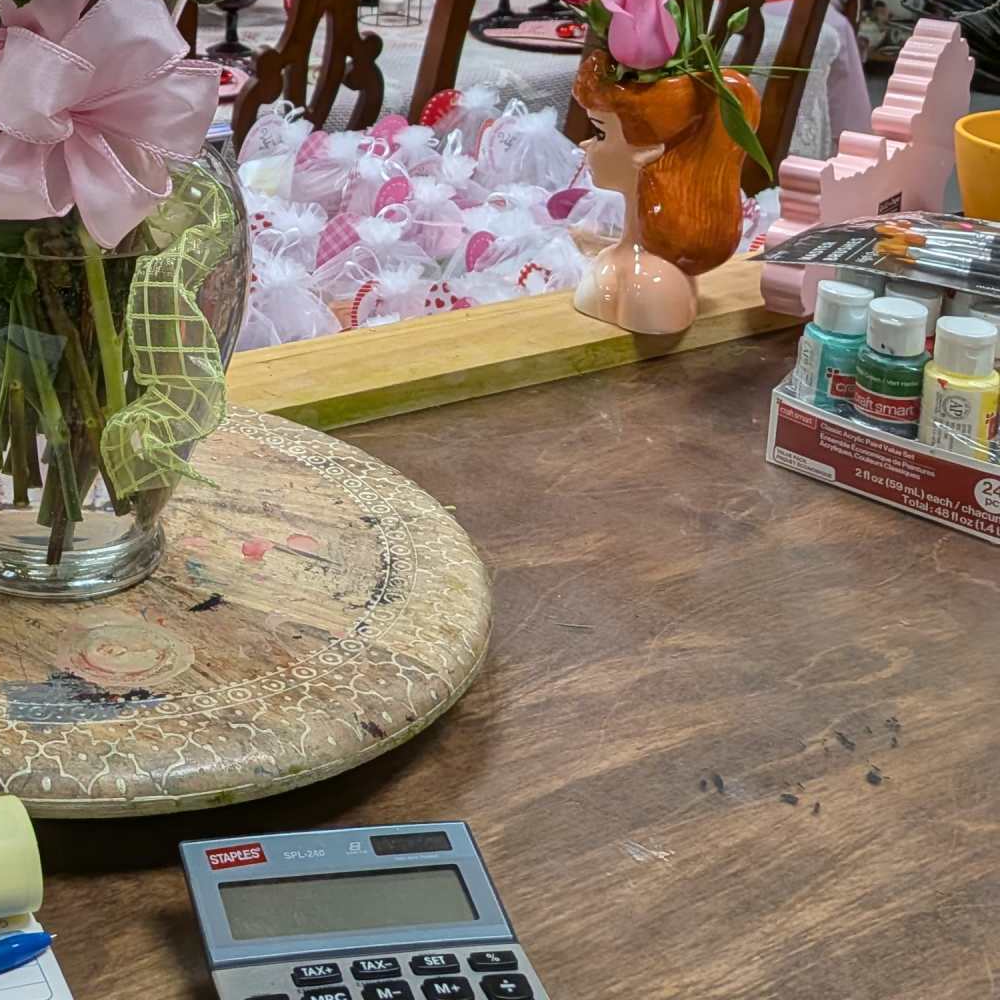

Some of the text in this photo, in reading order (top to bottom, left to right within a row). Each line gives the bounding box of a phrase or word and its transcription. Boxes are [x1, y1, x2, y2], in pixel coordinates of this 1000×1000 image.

[874, 403, 914, 417] smart
[843, 430, 866, 444] Acrylic
[883, 443, 902, 456] Value
[902, 449, 915, 460] Set
[855, 468, 862, 478] 2
[863, 469, 871, 481] fl
[871, 475, 885, 486] oz
[885, 478, 904, 491] (59
[904, 486, 925, 500] mL)
[926, 493, 953, 509] each
[901, 493, 929, 511] Total
[934, 506, 950, 519] 48
[951, 511, 960, 521] fl
[960, 516, 975, 528] oz
[974, 519, 995, 534] (1.4
[423, 955, 446, 966] SET
[485, 952, 501, 962] %
[301, 965, 334, 977] TAX+
[360, 960, 393, 970] TAX-
[375, 987, 402, 999] M-
[434, 983, 461, 994] M+
